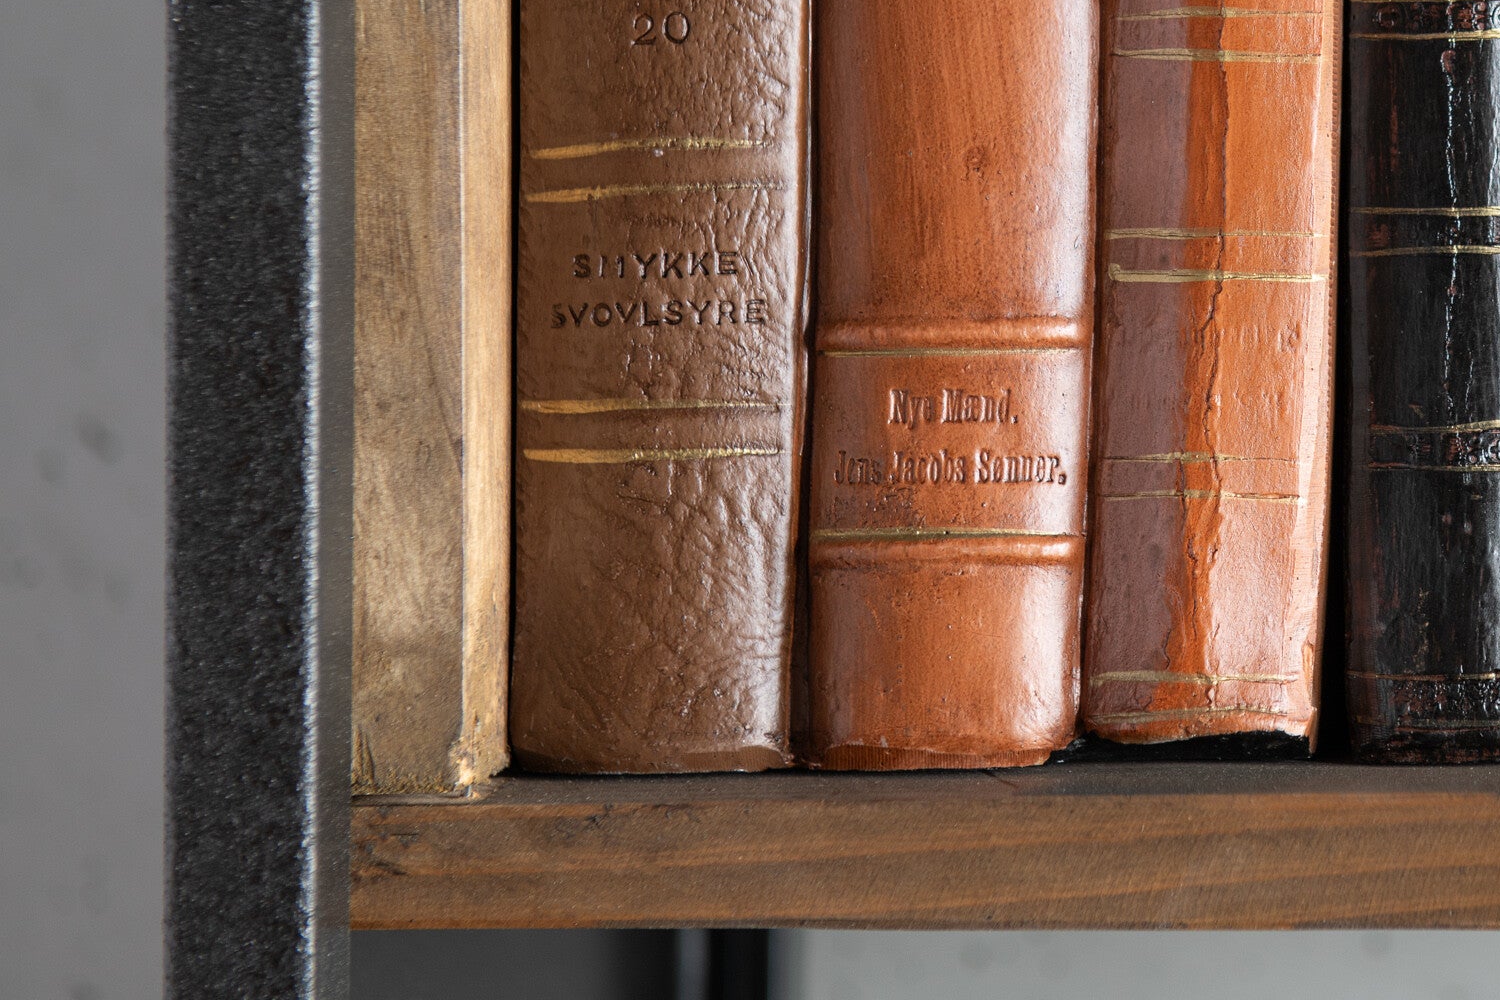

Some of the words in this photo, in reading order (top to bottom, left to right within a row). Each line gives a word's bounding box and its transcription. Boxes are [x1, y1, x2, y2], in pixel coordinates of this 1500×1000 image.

[630, 10, 691, 46] 20
[550, 298, 766, 329] SVOVLSYRE
[887, 387, 936, 431] Nye
[833, 449, 883, 486] Jens
[887, 449, 967, 486] Jacobs
